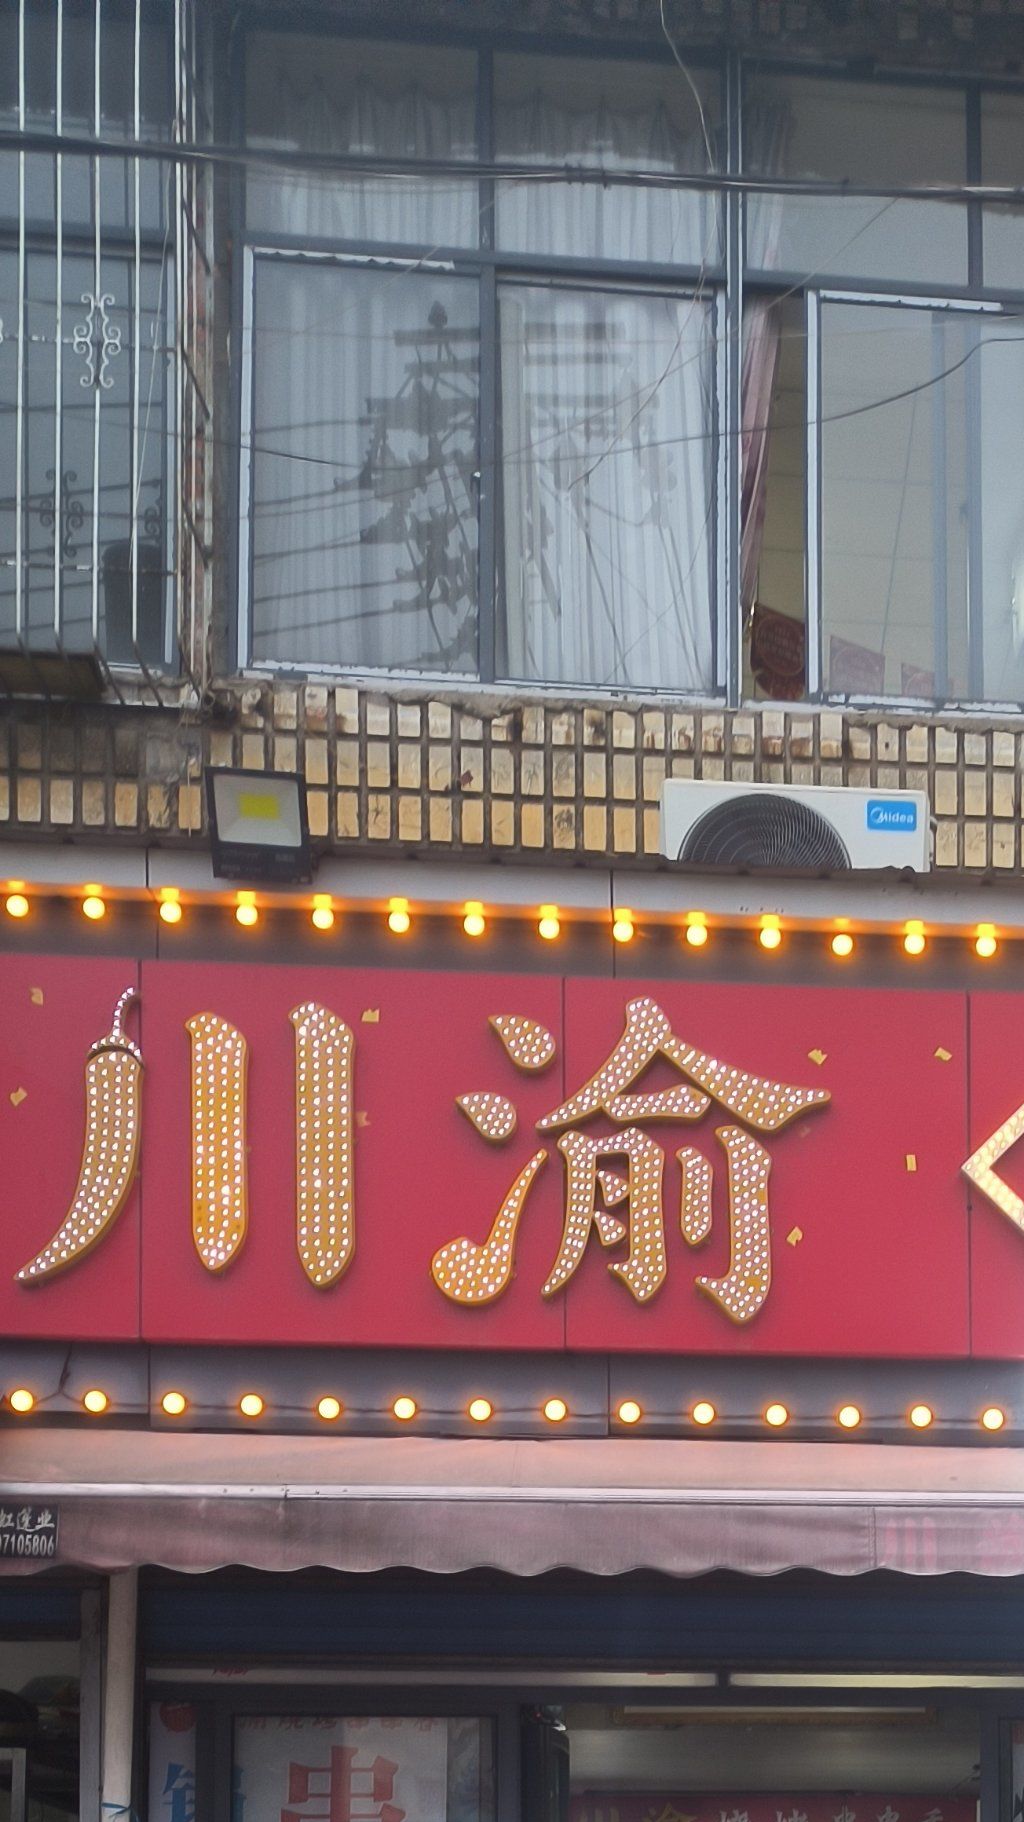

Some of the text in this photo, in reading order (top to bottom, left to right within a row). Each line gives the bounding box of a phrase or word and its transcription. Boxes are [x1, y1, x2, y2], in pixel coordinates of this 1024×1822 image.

[869, 806, 916, 826] Midea
[14, 986, 832, 1325] 川渝
[0, 1533, 55, 1557] 7105806
